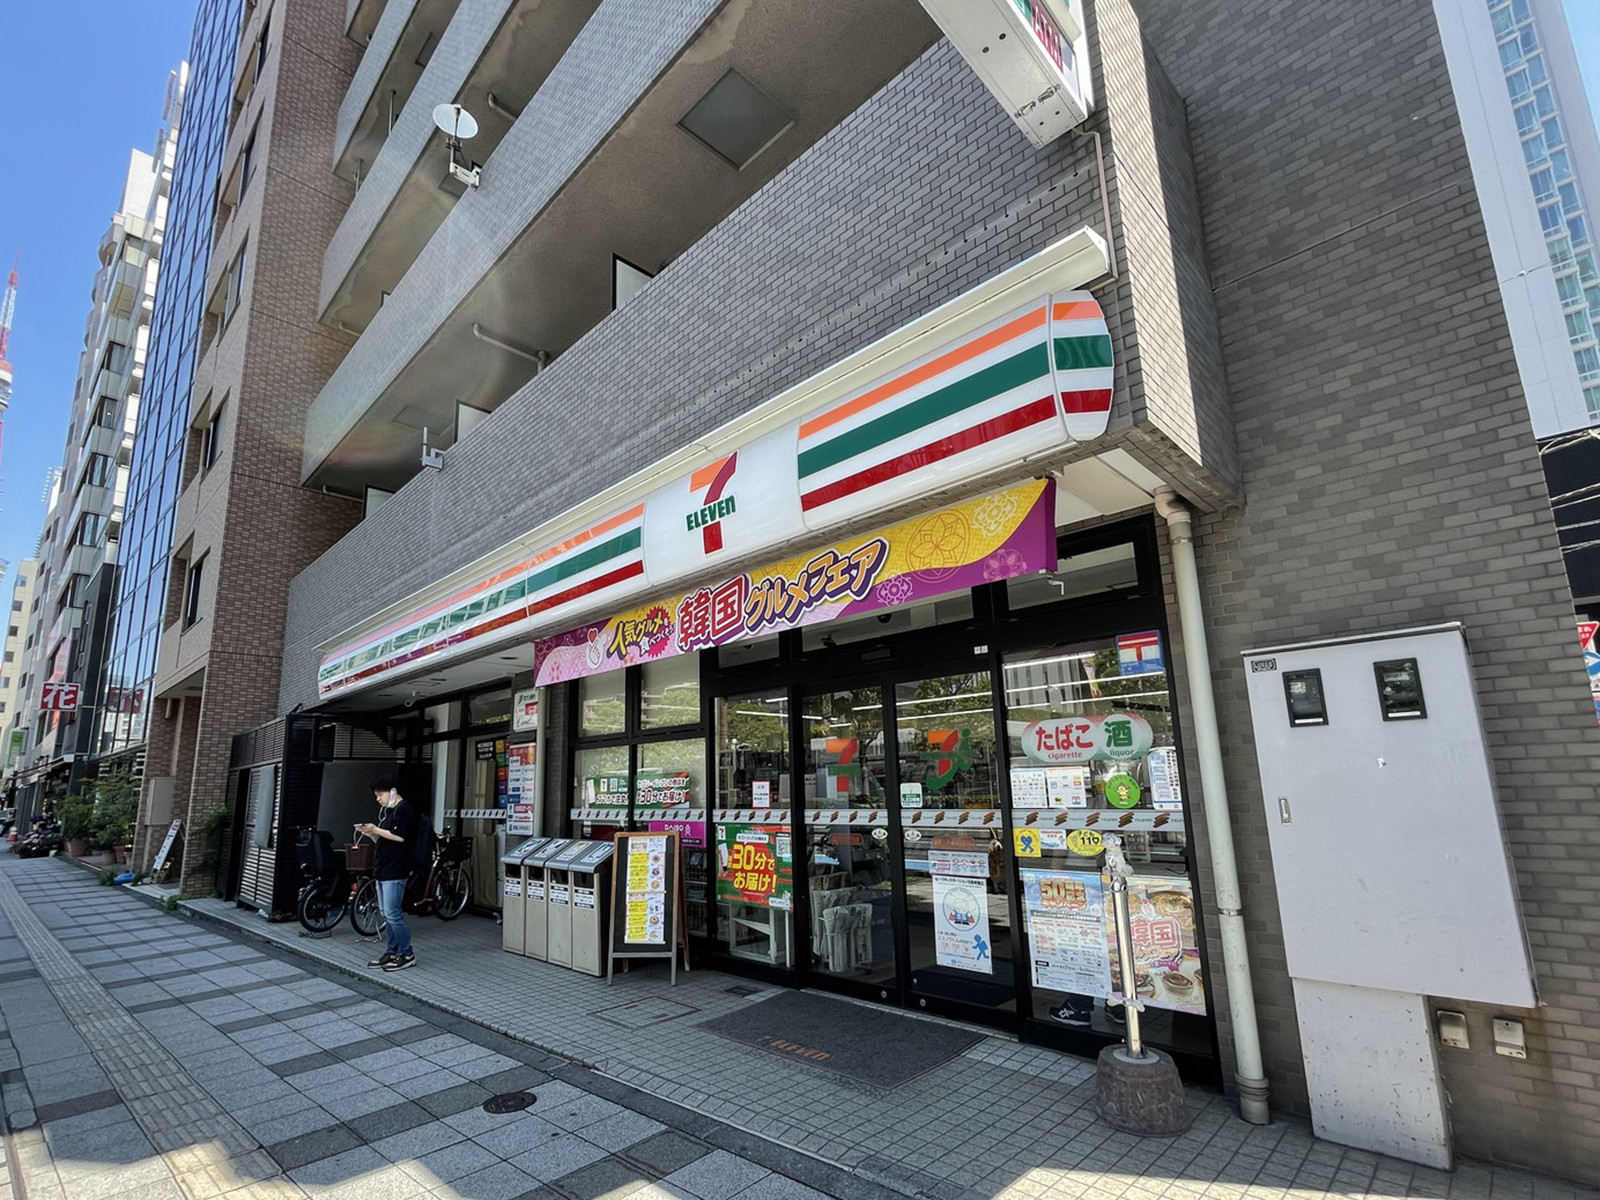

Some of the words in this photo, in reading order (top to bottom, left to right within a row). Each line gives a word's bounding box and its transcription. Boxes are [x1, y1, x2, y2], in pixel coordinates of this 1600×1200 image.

[43, 685, 77, 710] 花
[1035, 722, 1094, 751] たばこ
[1104, 719, 1134, 748] 酒
[1047, 750, 1083, 760] cigarette
[1109, 748, 1134, 756] liquor
[733, 871, 778, 894] お届け!
